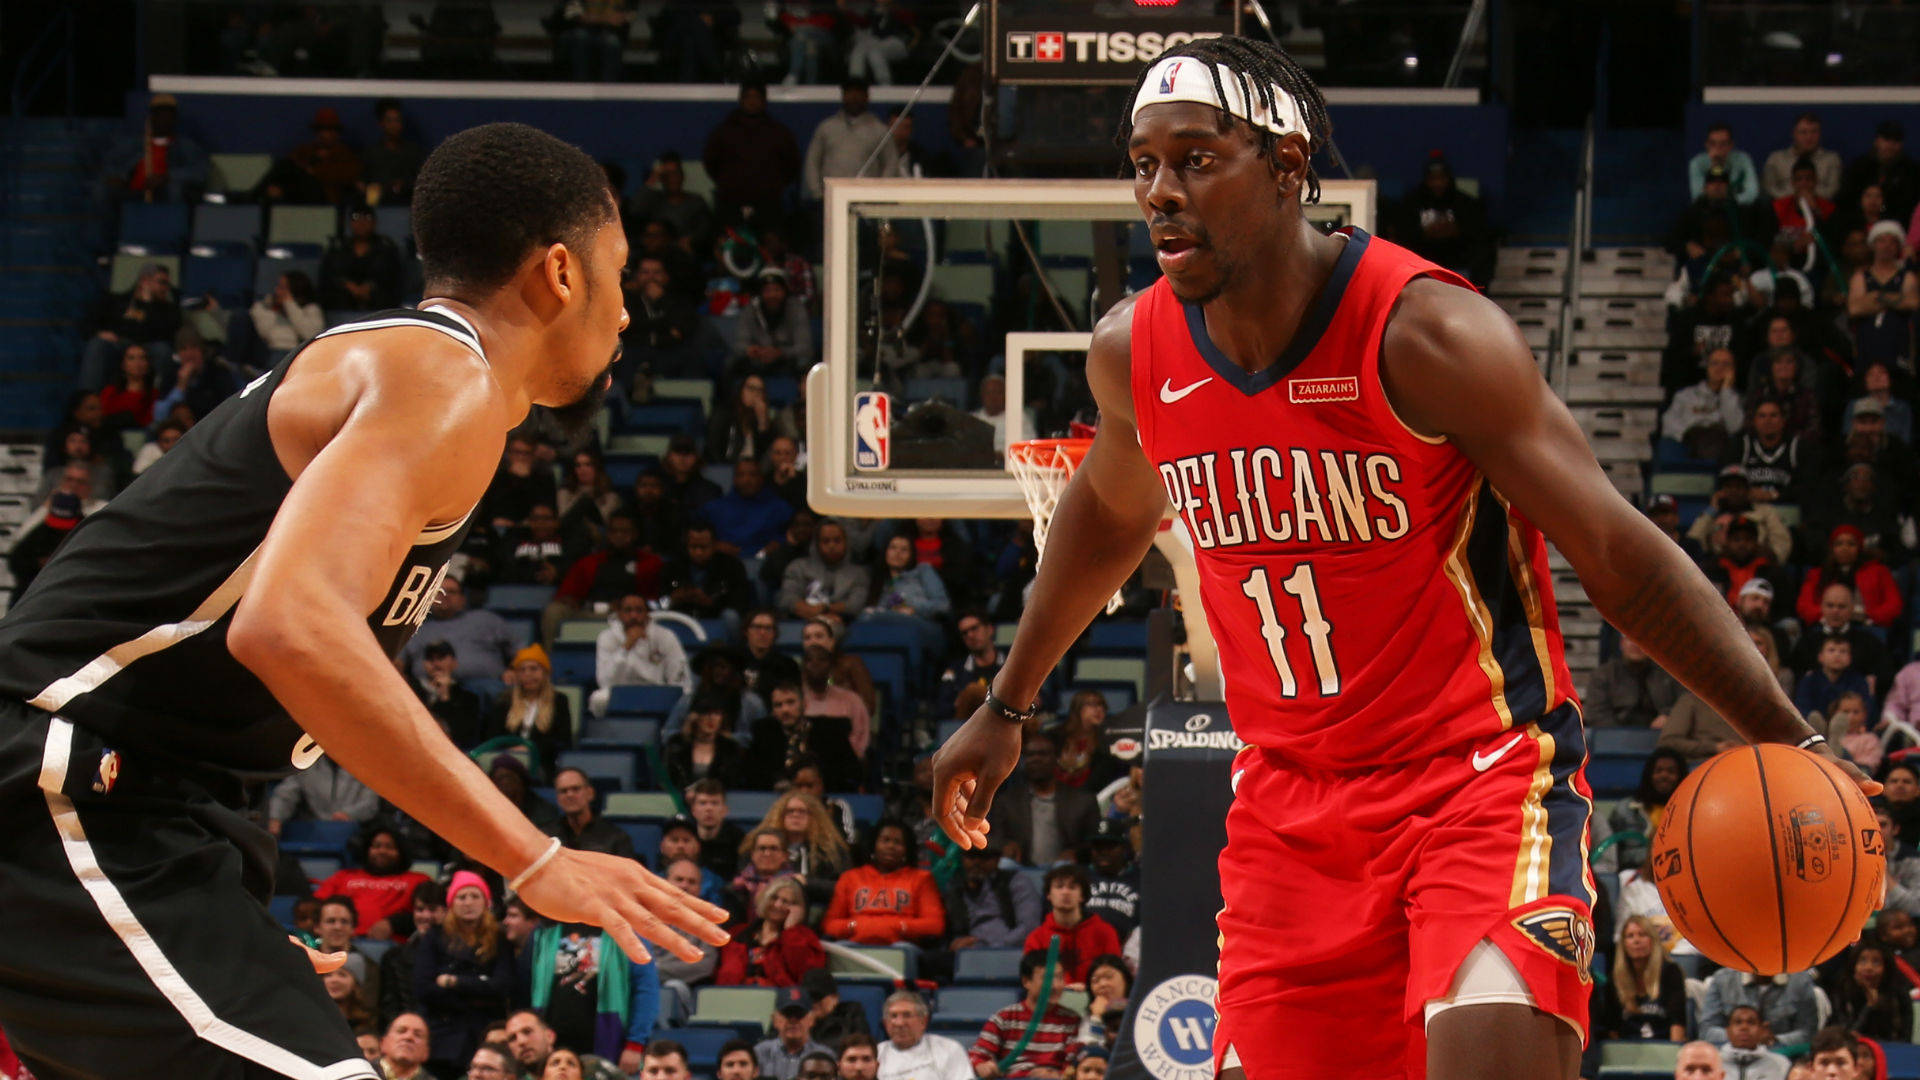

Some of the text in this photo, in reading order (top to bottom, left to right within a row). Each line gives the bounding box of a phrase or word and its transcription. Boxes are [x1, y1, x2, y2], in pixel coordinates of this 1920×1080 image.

[1066, 32, 1223, 62] TISS
[1297, 382, 1354, 395] ZATARAINS
[1157, 446, 1410, 549] PELICANS
[1240, 562, 1341, 698] 11
[854, 887, 911, 912] GAP
[1140, 979, 1215, 1023] HANCO
